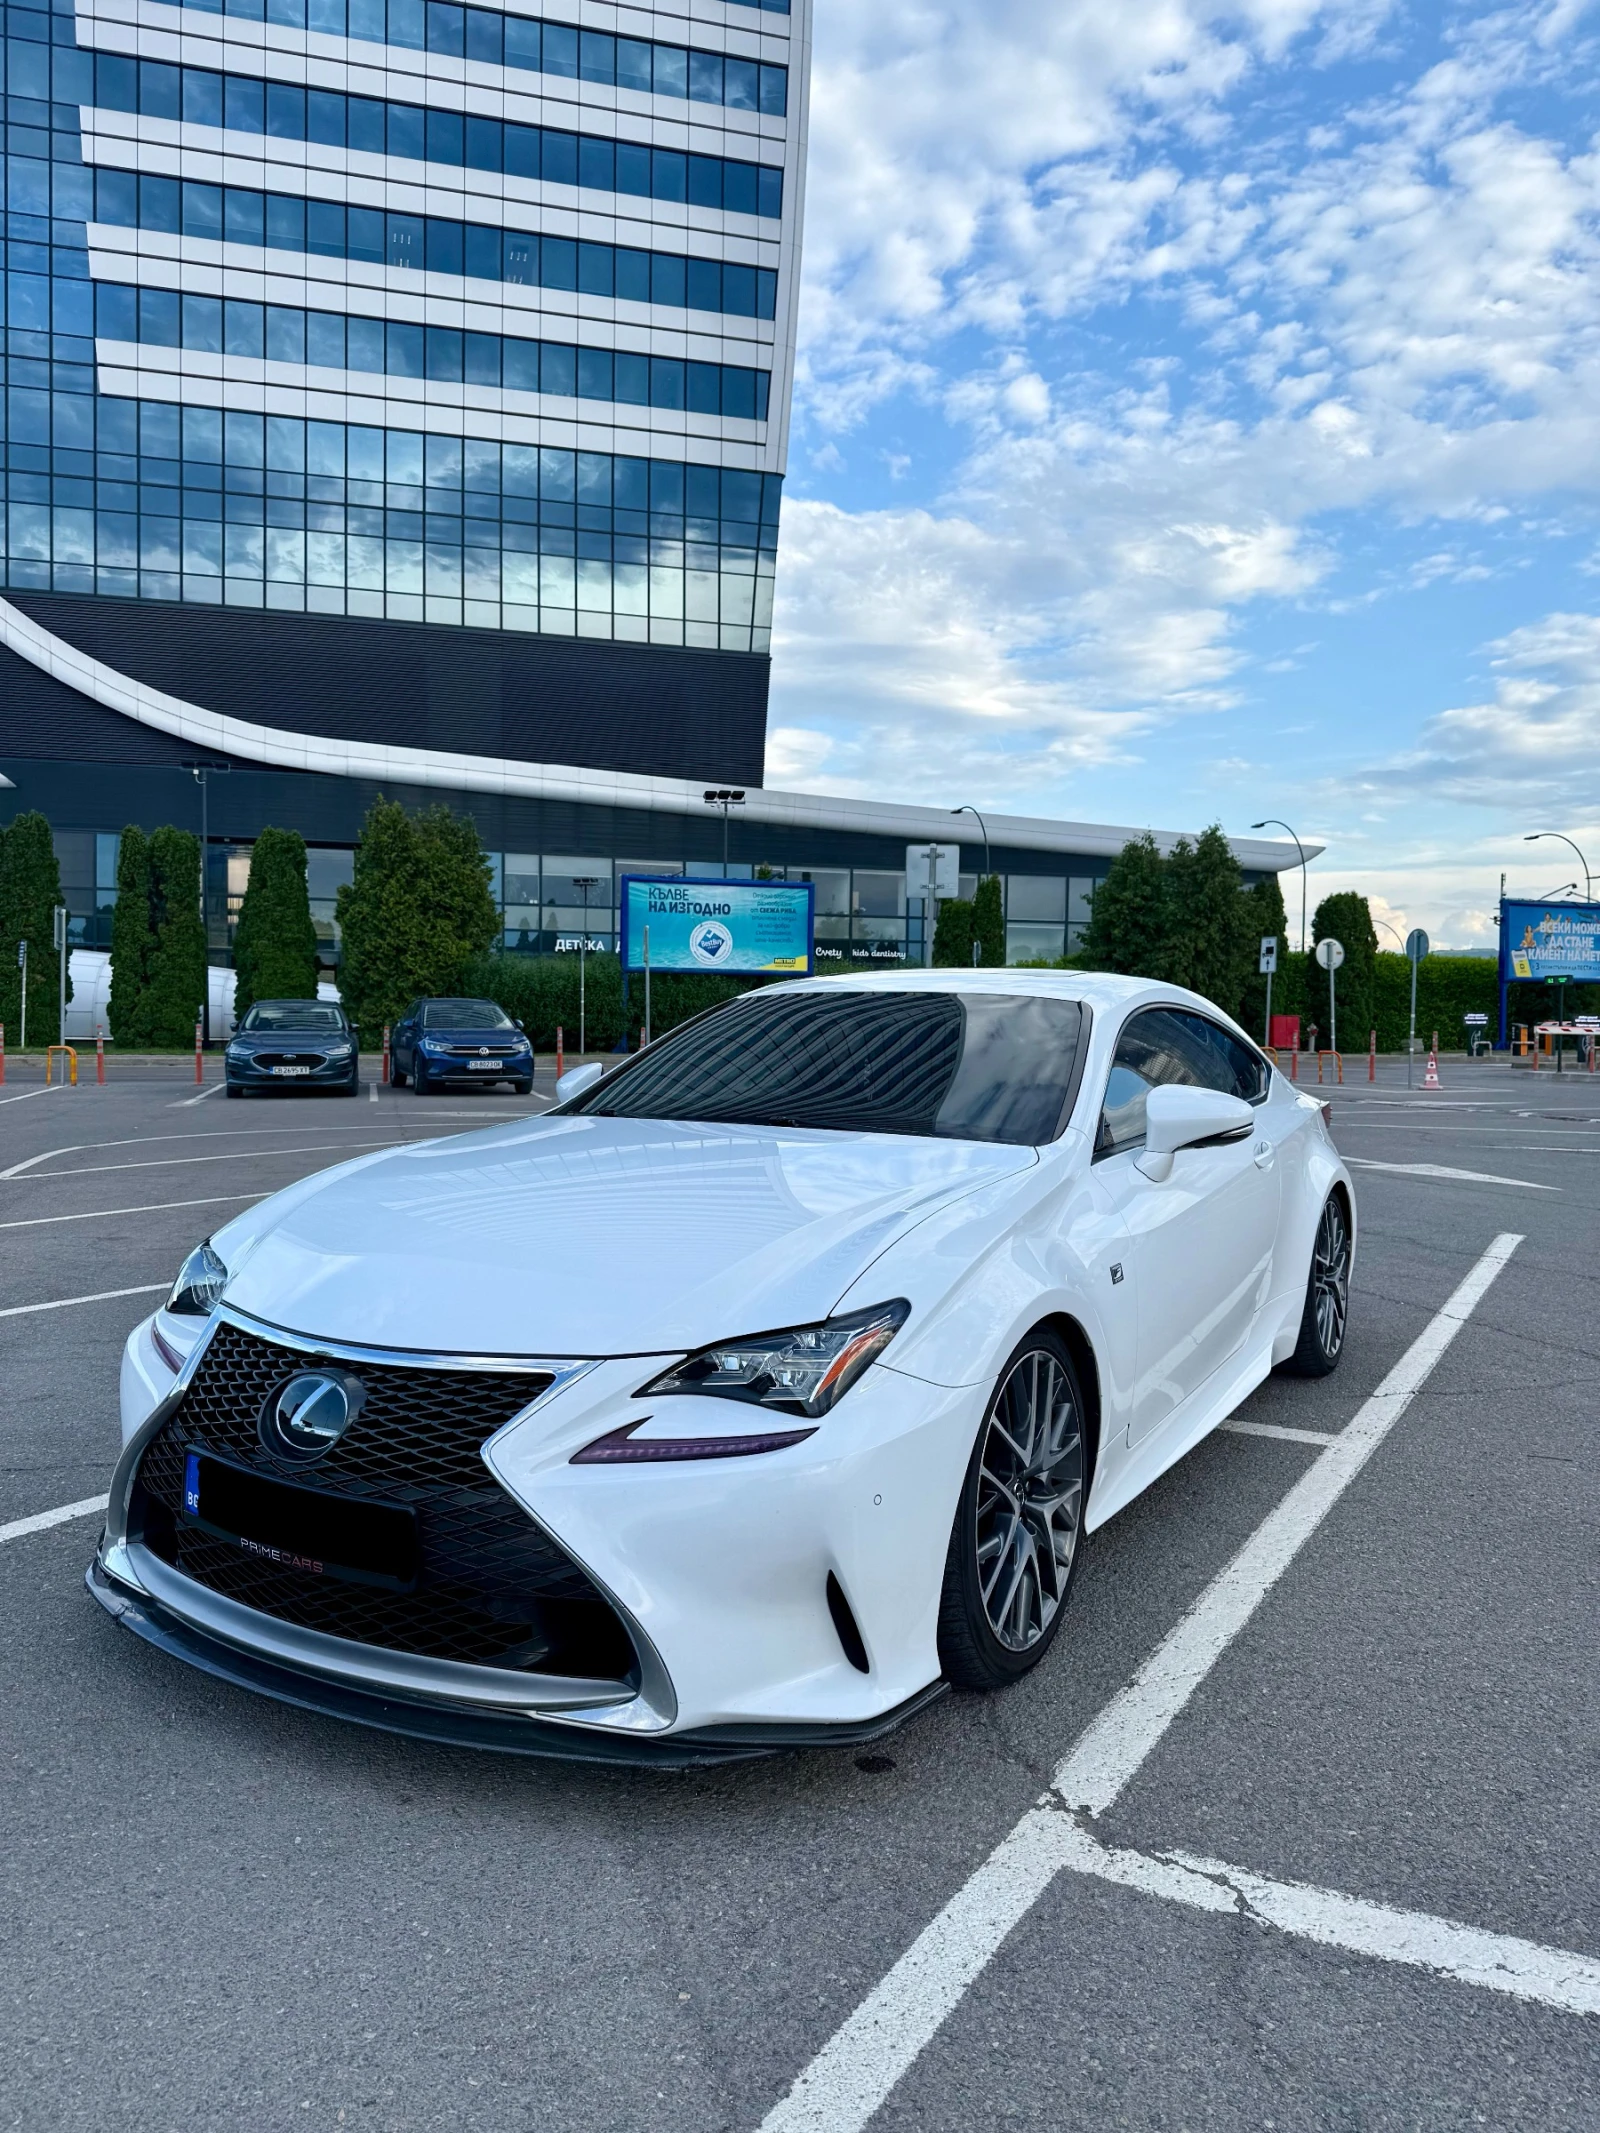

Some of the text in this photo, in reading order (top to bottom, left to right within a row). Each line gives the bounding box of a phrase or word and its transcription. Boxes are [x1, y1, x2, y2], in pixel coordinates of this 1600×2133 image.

[648, 887, 689, 901] КЪЛВЕ
[648, 900, 731, 917] НА ИЗГОДНО
[1540, 921, 1571, 934] ВСЕКИ
[1564, 936, 1594, 949] СТАНЕ
[815, 946, 842, 959] Cvety
[852, 948, 906, 960] kids dentistry
[1528, 949, 1567, 960] КЛИЕНТ
[1567, 950, 1581, 962] НА
